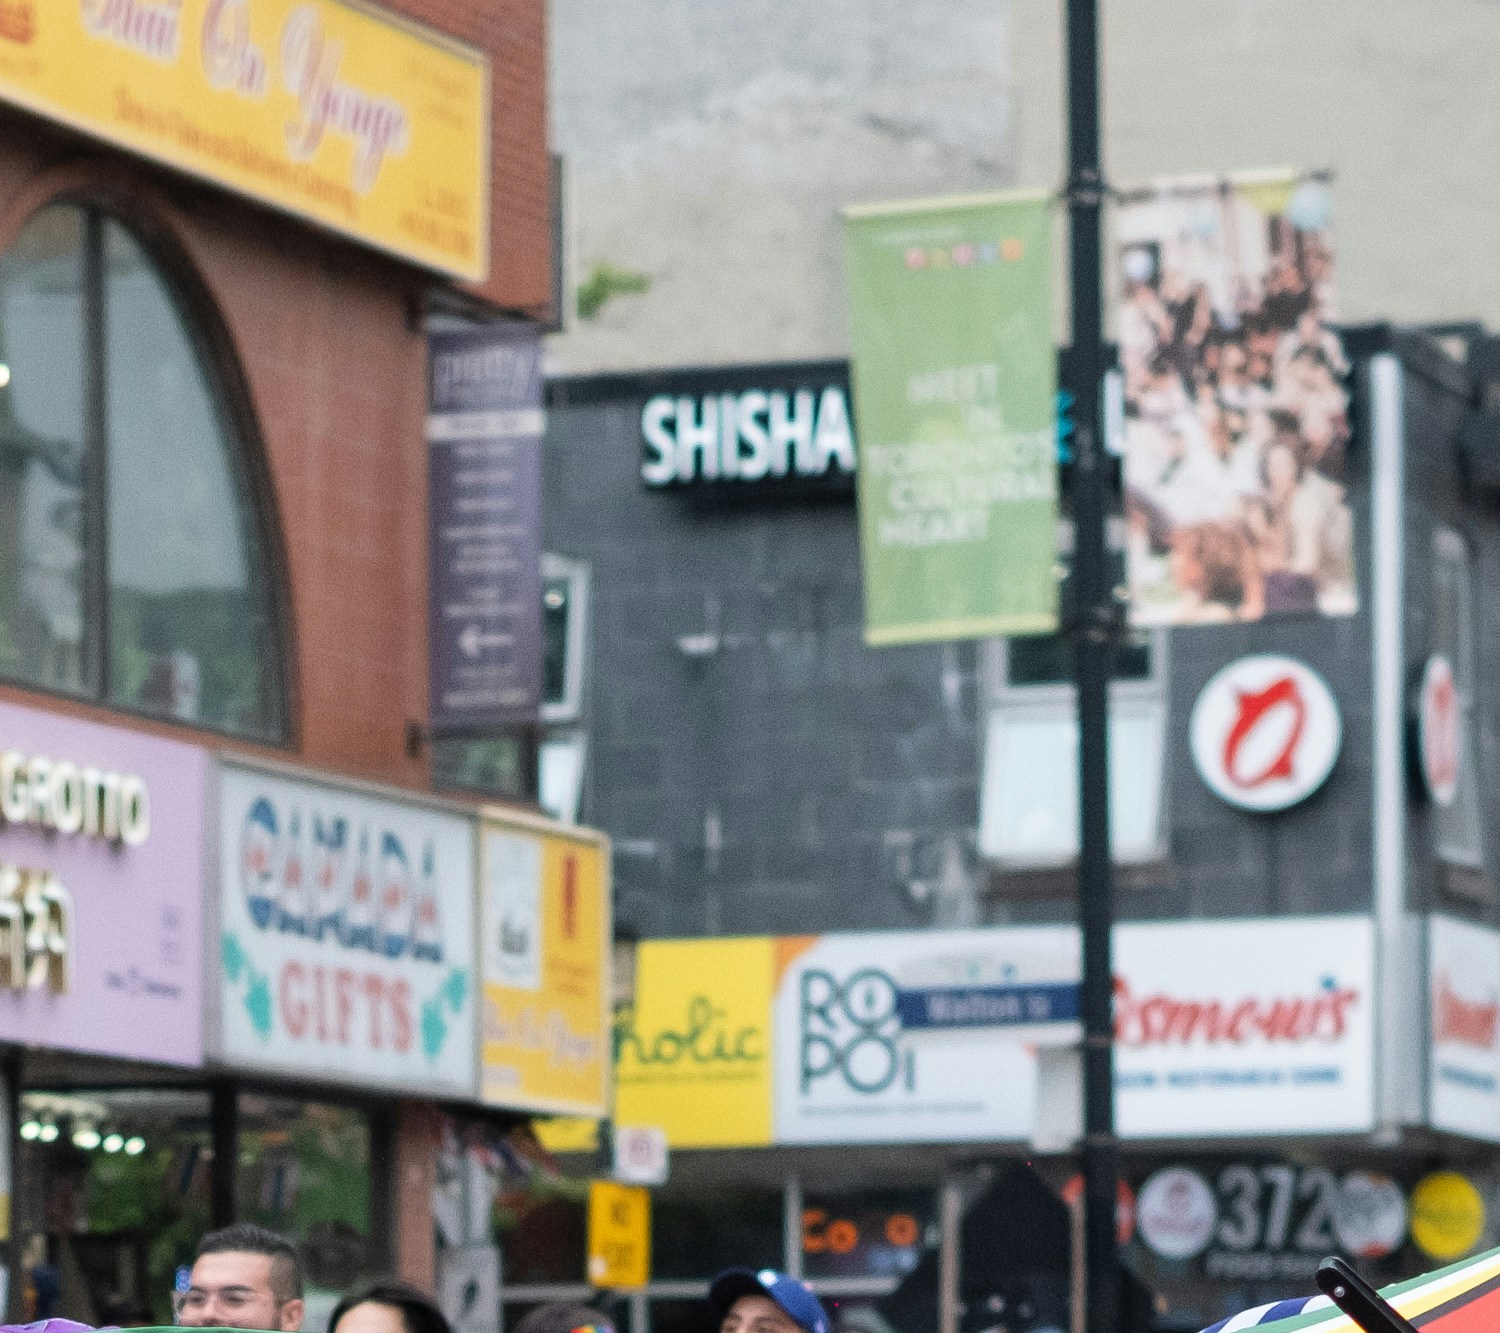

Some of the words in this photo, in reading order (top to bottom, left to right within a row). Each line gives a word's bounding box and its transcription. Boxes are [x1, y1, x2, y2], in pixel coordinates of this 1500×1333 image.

[641, 386, 858, 484] SHISHA
[878, 509, 989, 547] HEART
[280, 957, 414, 1056] GIFTS
[1219, 1166, 1337, 1250] 372
